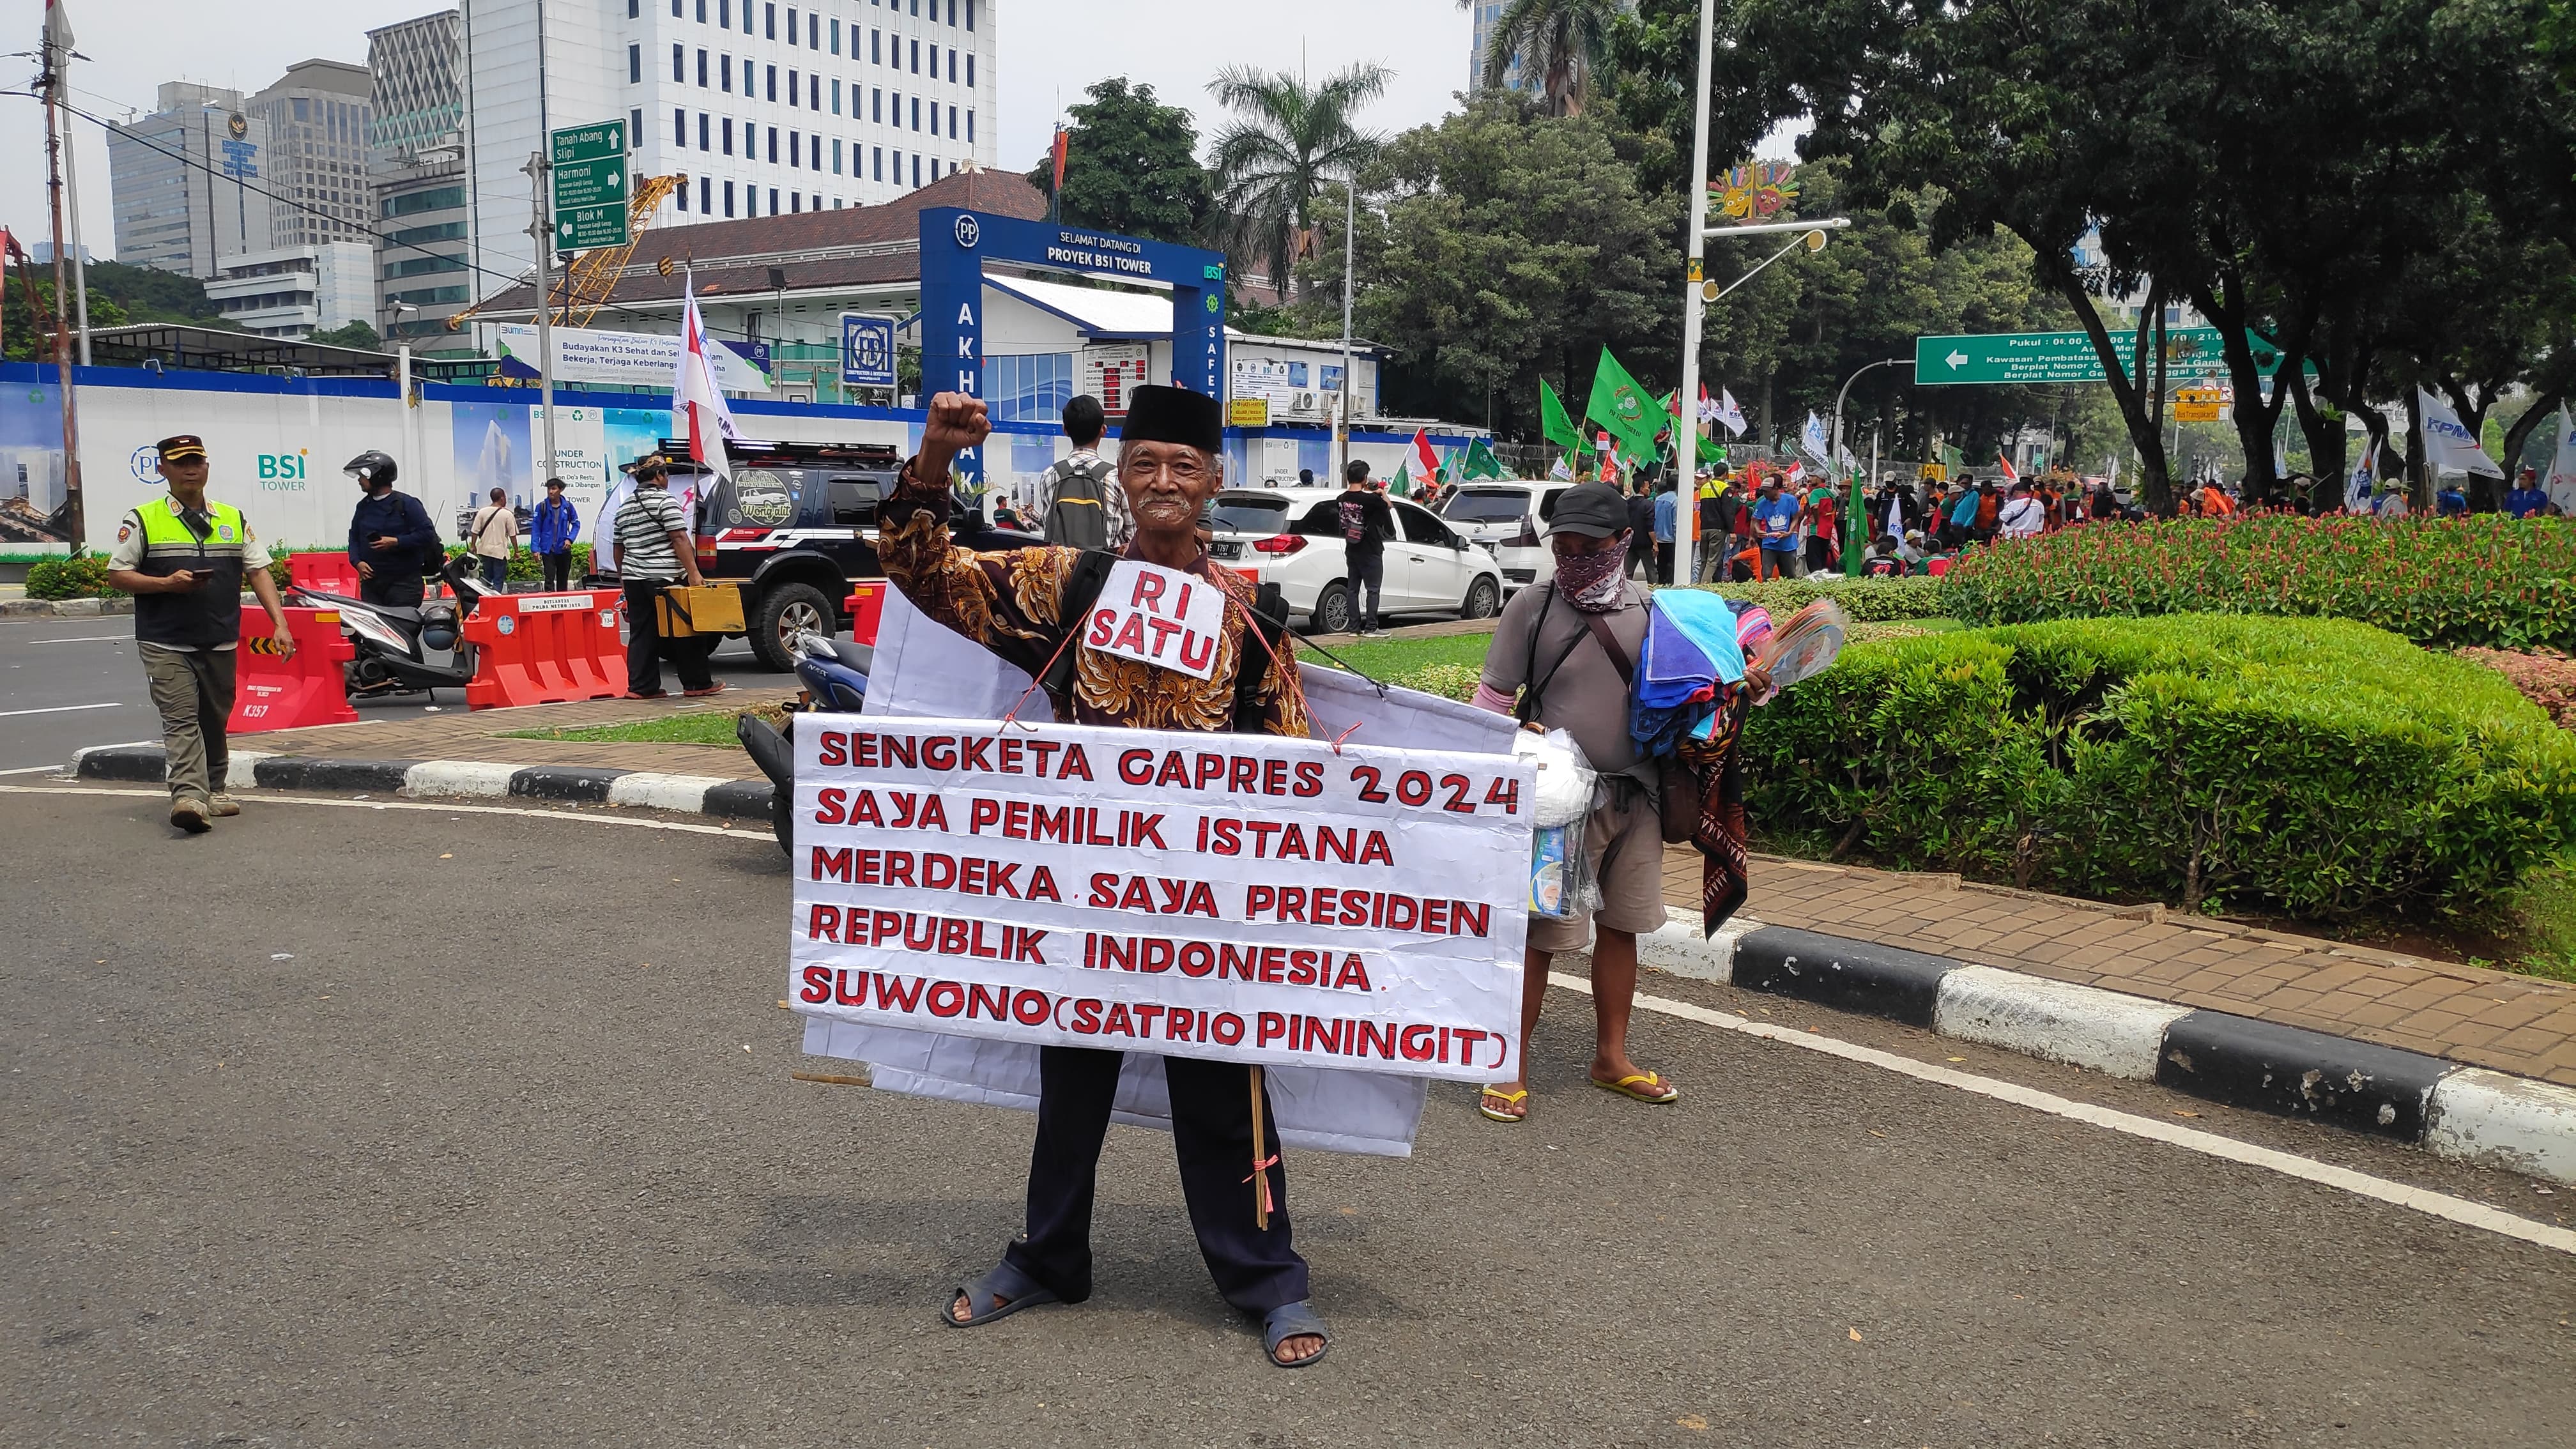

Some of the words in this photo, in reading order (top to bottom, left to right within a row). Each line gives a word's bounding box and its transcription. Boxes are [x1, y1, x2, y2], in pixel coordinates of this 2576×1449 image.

[556, 133, 578, 146] Tanah
[579, 131, 603, 143] Abang
[556, 146, 574, 161] Slipi
[558, 165, 591, 180] Harmoni
[577, 210, 595, 222] Blok
[597, 209, 604, 220] M
[1060, 231, 1098, 248] SELAMAT
[1100, 238, 1132, 252] DATANG
[1133, 242, 1141, 254] DI
[1048, 247, 1092, 266] PROYEK
[1094, 252, 1112, 268] BSI
[1115, 255, 1152, 275] TOWER
[1204, 266, 1222, 280] BSI
[562, 342, 610, 353] Budayakan
[611, 346, 623, 354] K3
[625, 347, 648, 356] Sehat
[651, 348, 666, 356] dan
[2053, 338, 2082, 346] 06.00
[563, 355, 597, 365] Bekerja,
[600, 356, 631, 367] Terjaga
[634, 360, 678, 370] Keberlangs
[555, 449, 584, 458] UNDER
[257, 454, 305, 479] BSI
[261, 481, 306, 491] TOWER
[1216, 544, 1229, 553] 1797
[1089, 608, 1215, 671] SATU
[243, 704, 269, 717] K357
[819, 732, 1093, 782] SENGKETA
[1350, 765, 1519, 815] 2024
[815, 788, 949, 832] SAYA
[969, 797, 1169, 850] PEMILIK
[1196, 815, 1395, 867] ISTANA
[1088, 873, 1220, 918] SAYA
[1245, 884, 1491, 938] PRESIDEN
[809, 903, 1050, 965] REPUBLIK
[1257, 1011, 1508, 1070] PININGIT)
